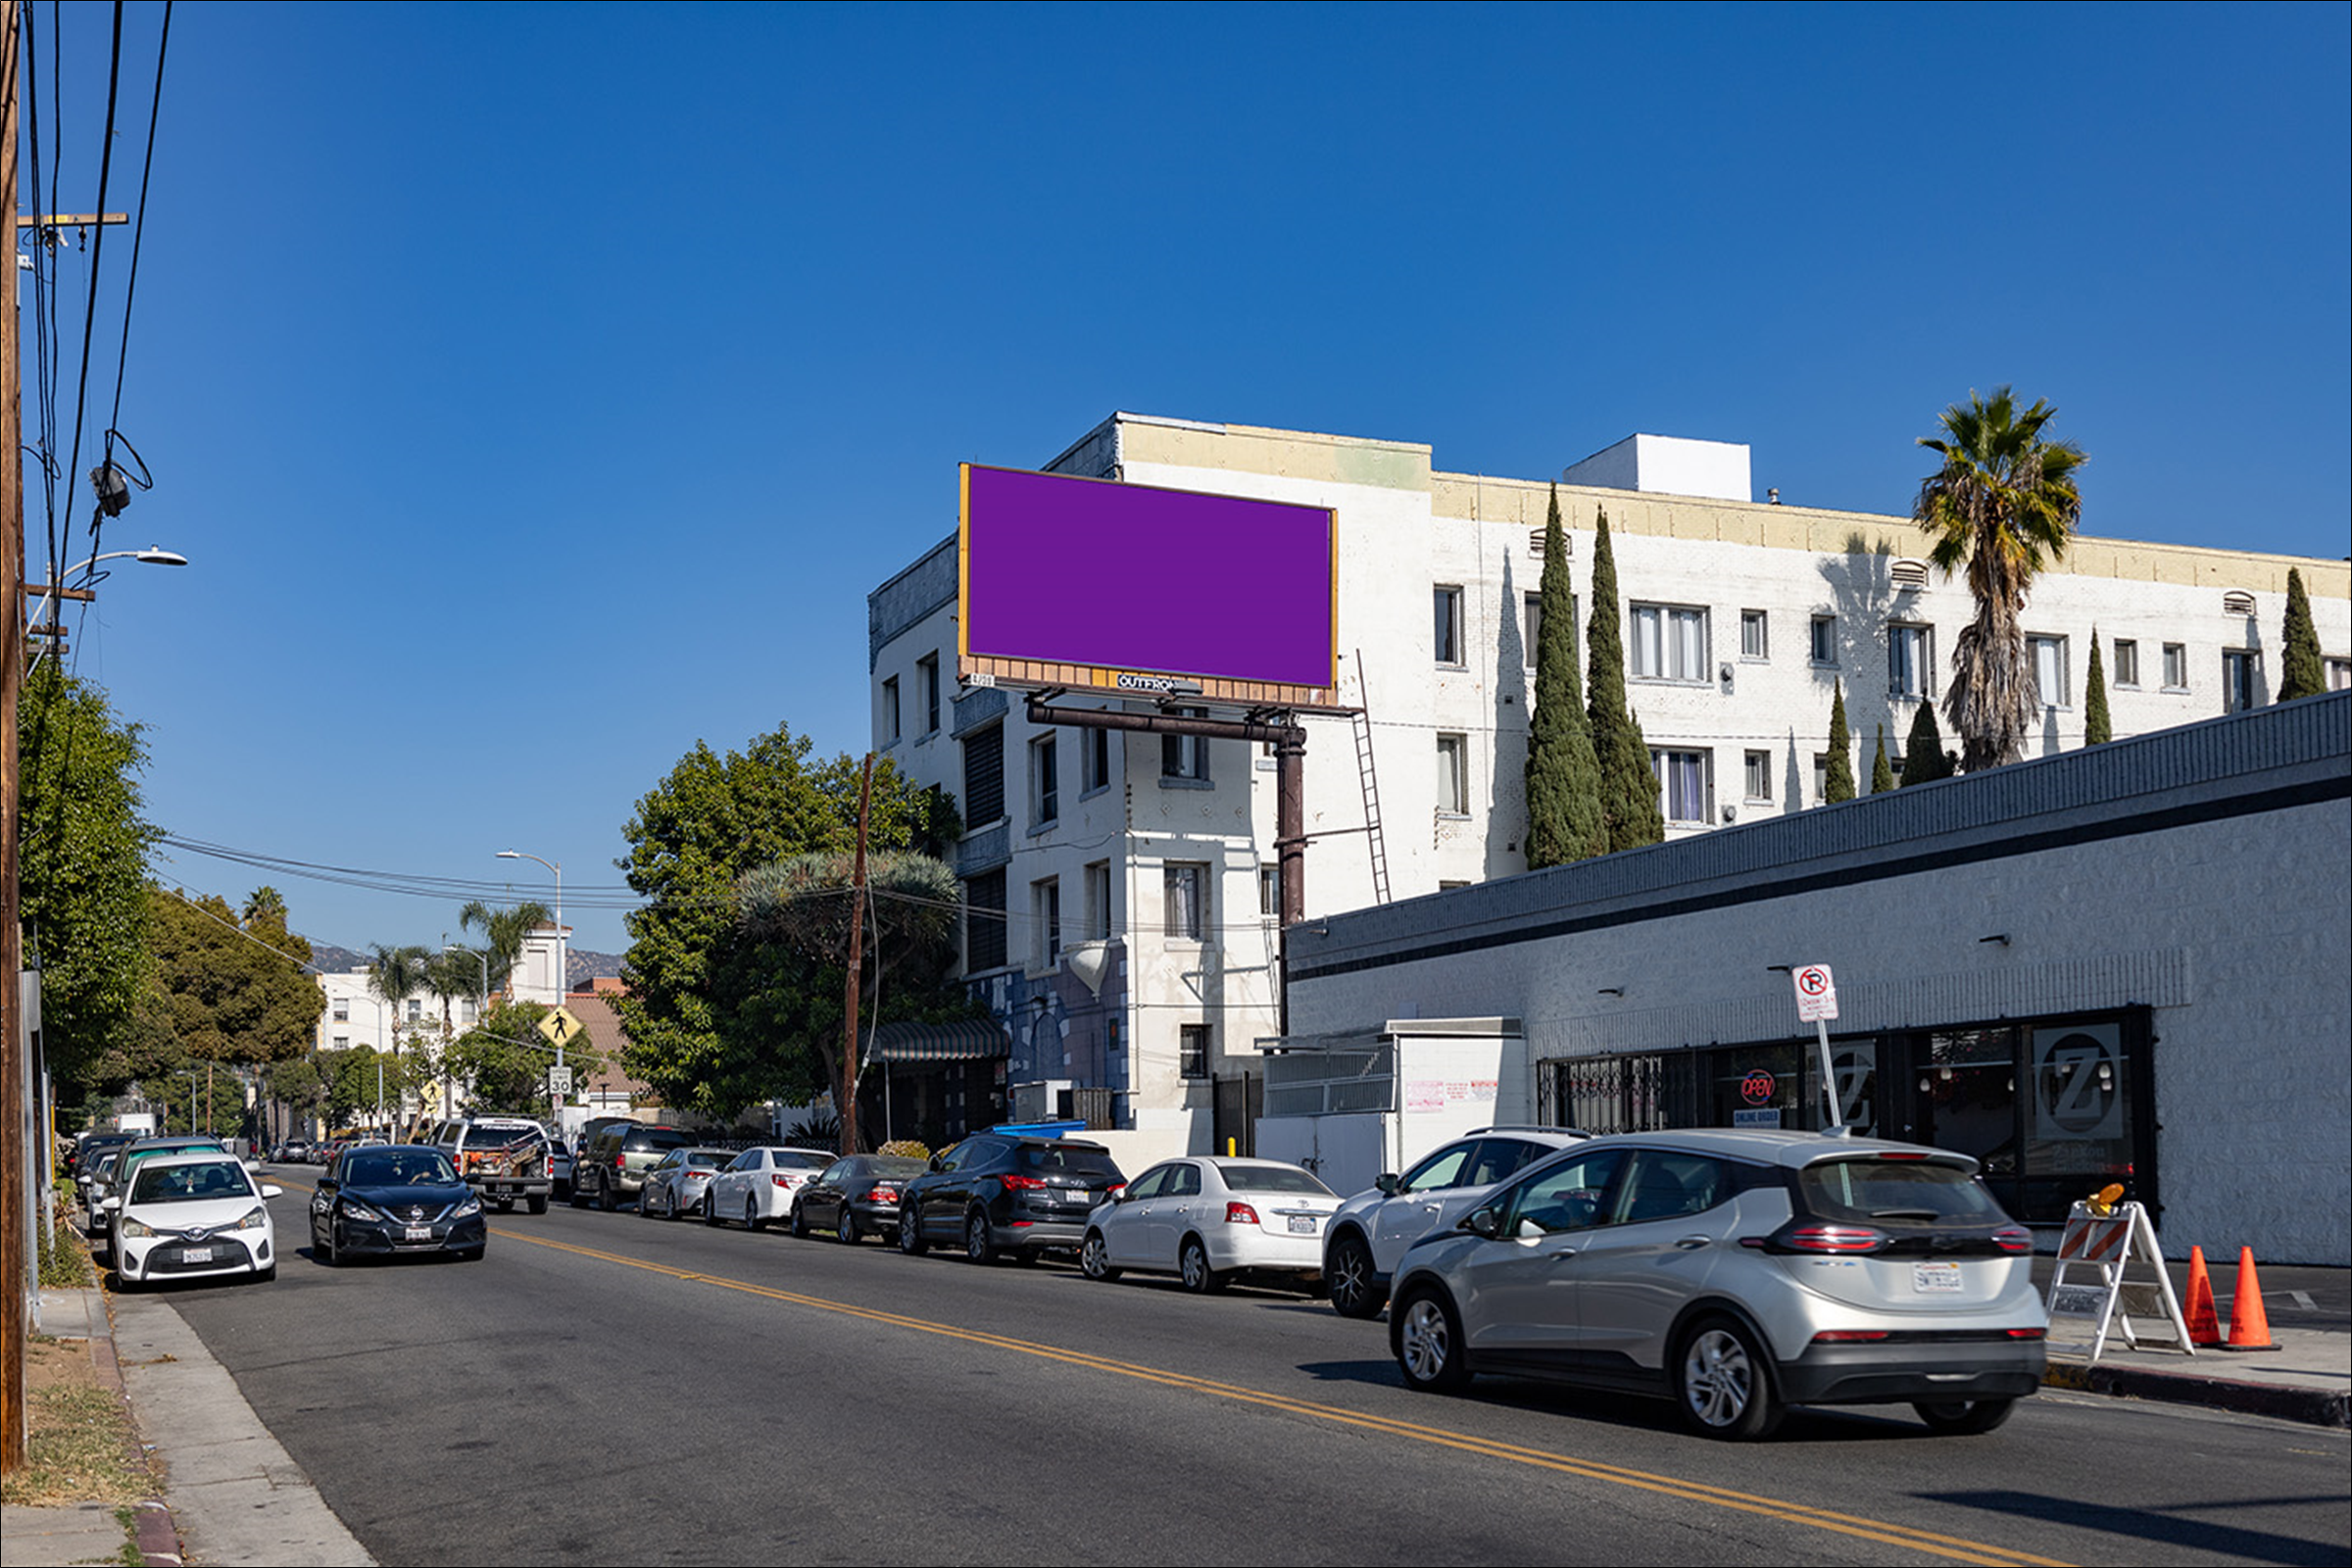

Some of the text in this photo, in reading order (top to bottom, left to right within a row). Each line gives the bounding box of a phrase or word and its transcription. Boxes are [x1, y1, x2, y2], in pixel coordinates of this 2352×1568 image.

[1119, 675, 1179, 691] OUTFRON
[552, 1081, 569, 1092] 30
[1742, 1078, 1773, 1097] OPEN
[1736, 1110, 1779, 1123] ONLINE ORDER
